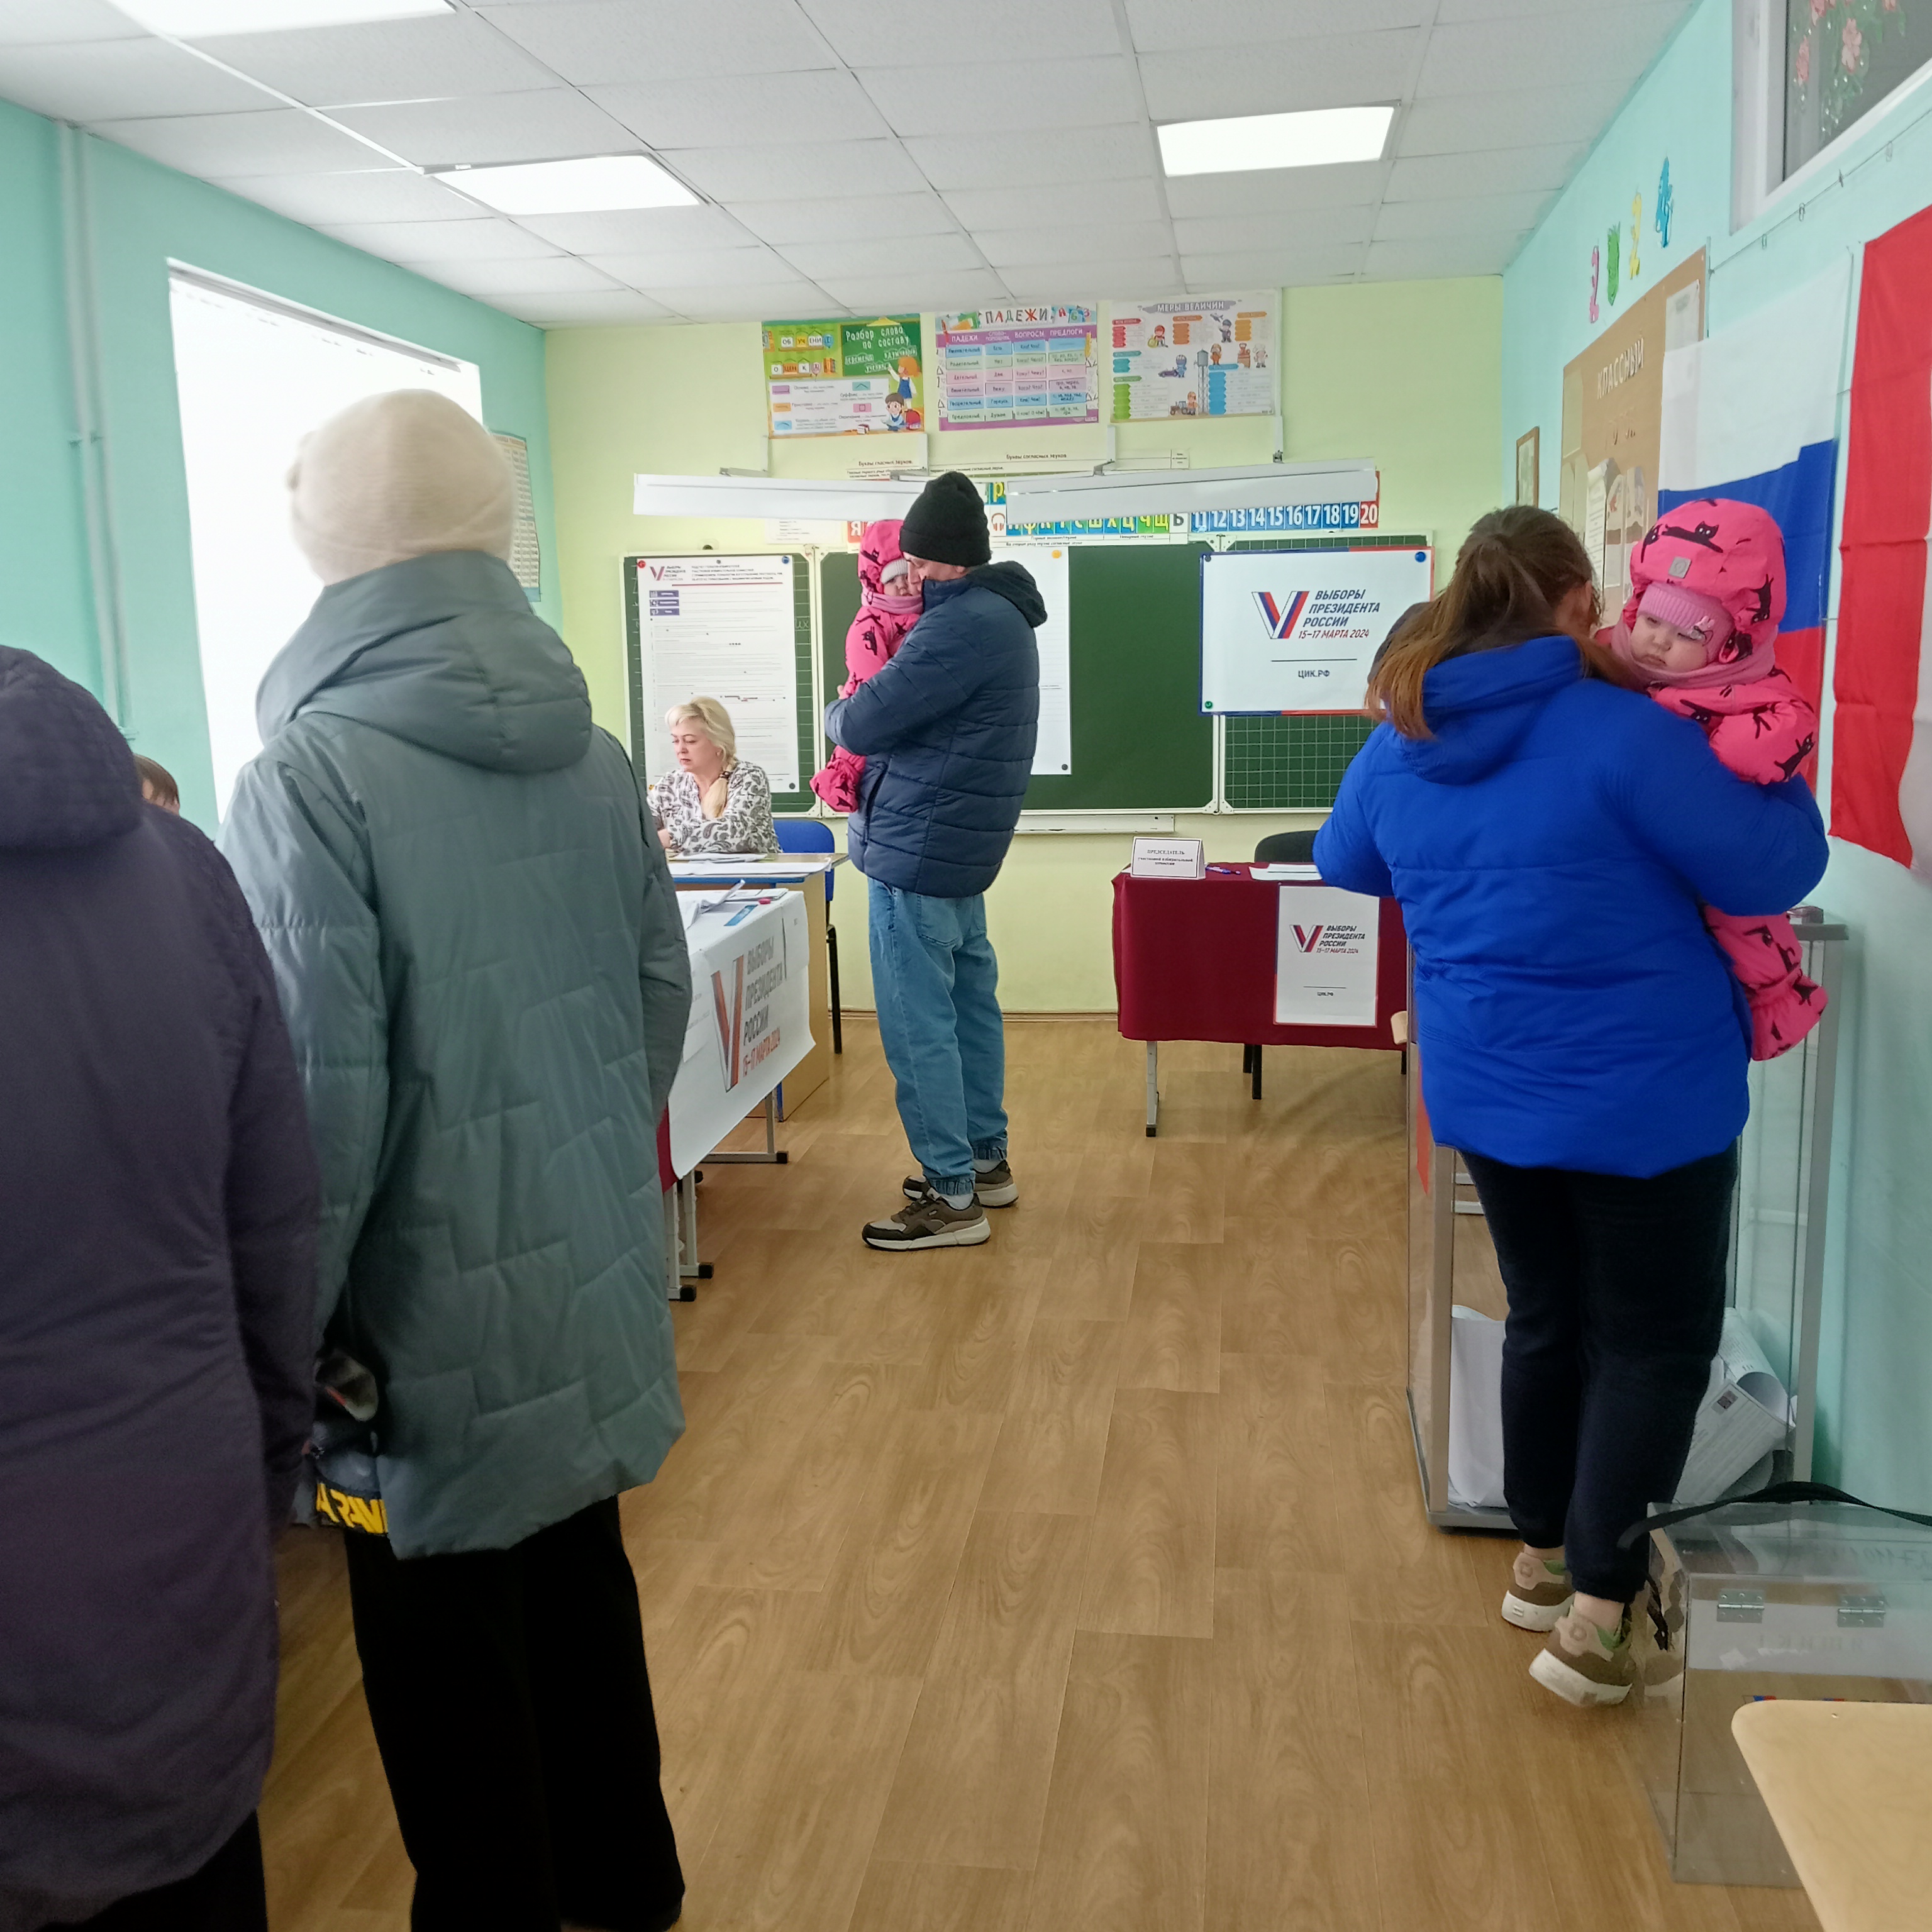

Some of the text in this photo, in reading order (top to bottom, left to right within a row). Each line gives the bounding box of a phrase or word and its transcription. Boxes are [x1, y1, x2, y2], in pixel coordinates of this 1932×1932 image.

[1157, 301, 1224, 312] МЕРЫ ВЕЛИЧИН
[985, 308, 1048, 325] ПАДЕЖИ
[845, 326, 904, 341] Разбор слова
[1050, 328, 1083, 336] ПРЕДЛОГИ
[862, 336, 909, 349] по составу
[1211, 509, 1227, 527] 12
[1230, 509, 1246, 527] 13
[1249, 508, 1265, 526] 14
[1268, 507, 1283, 526] 15
[1287, 506, 1302, 525] 16
[1306, 505, 1321, 525] 17
[1324, 505, 1340, 525] 18
[1343, 504, 1358, 525] 19
[1360, 504, 1378, 524] 20
[1315, 589, 1366, 600] ВЫБОРЫ
[1309, 602, 1380, 614] ПРЕЗИДЕНТА
[1302, 617, 1350, 628] РОССИИ
[1321, 630, 1348, 638] МАРТА
[1349, 629, 1369, 638] 2024
[1298, 670, 1330, 679] ЦИК.РФ
[747, 936, 774, 975] ВЫБОРЫ
[745, 960, 783, 1011] ПРЕЗИДЕНТА
[743, 1004, 769, 1046] РОССИИ
